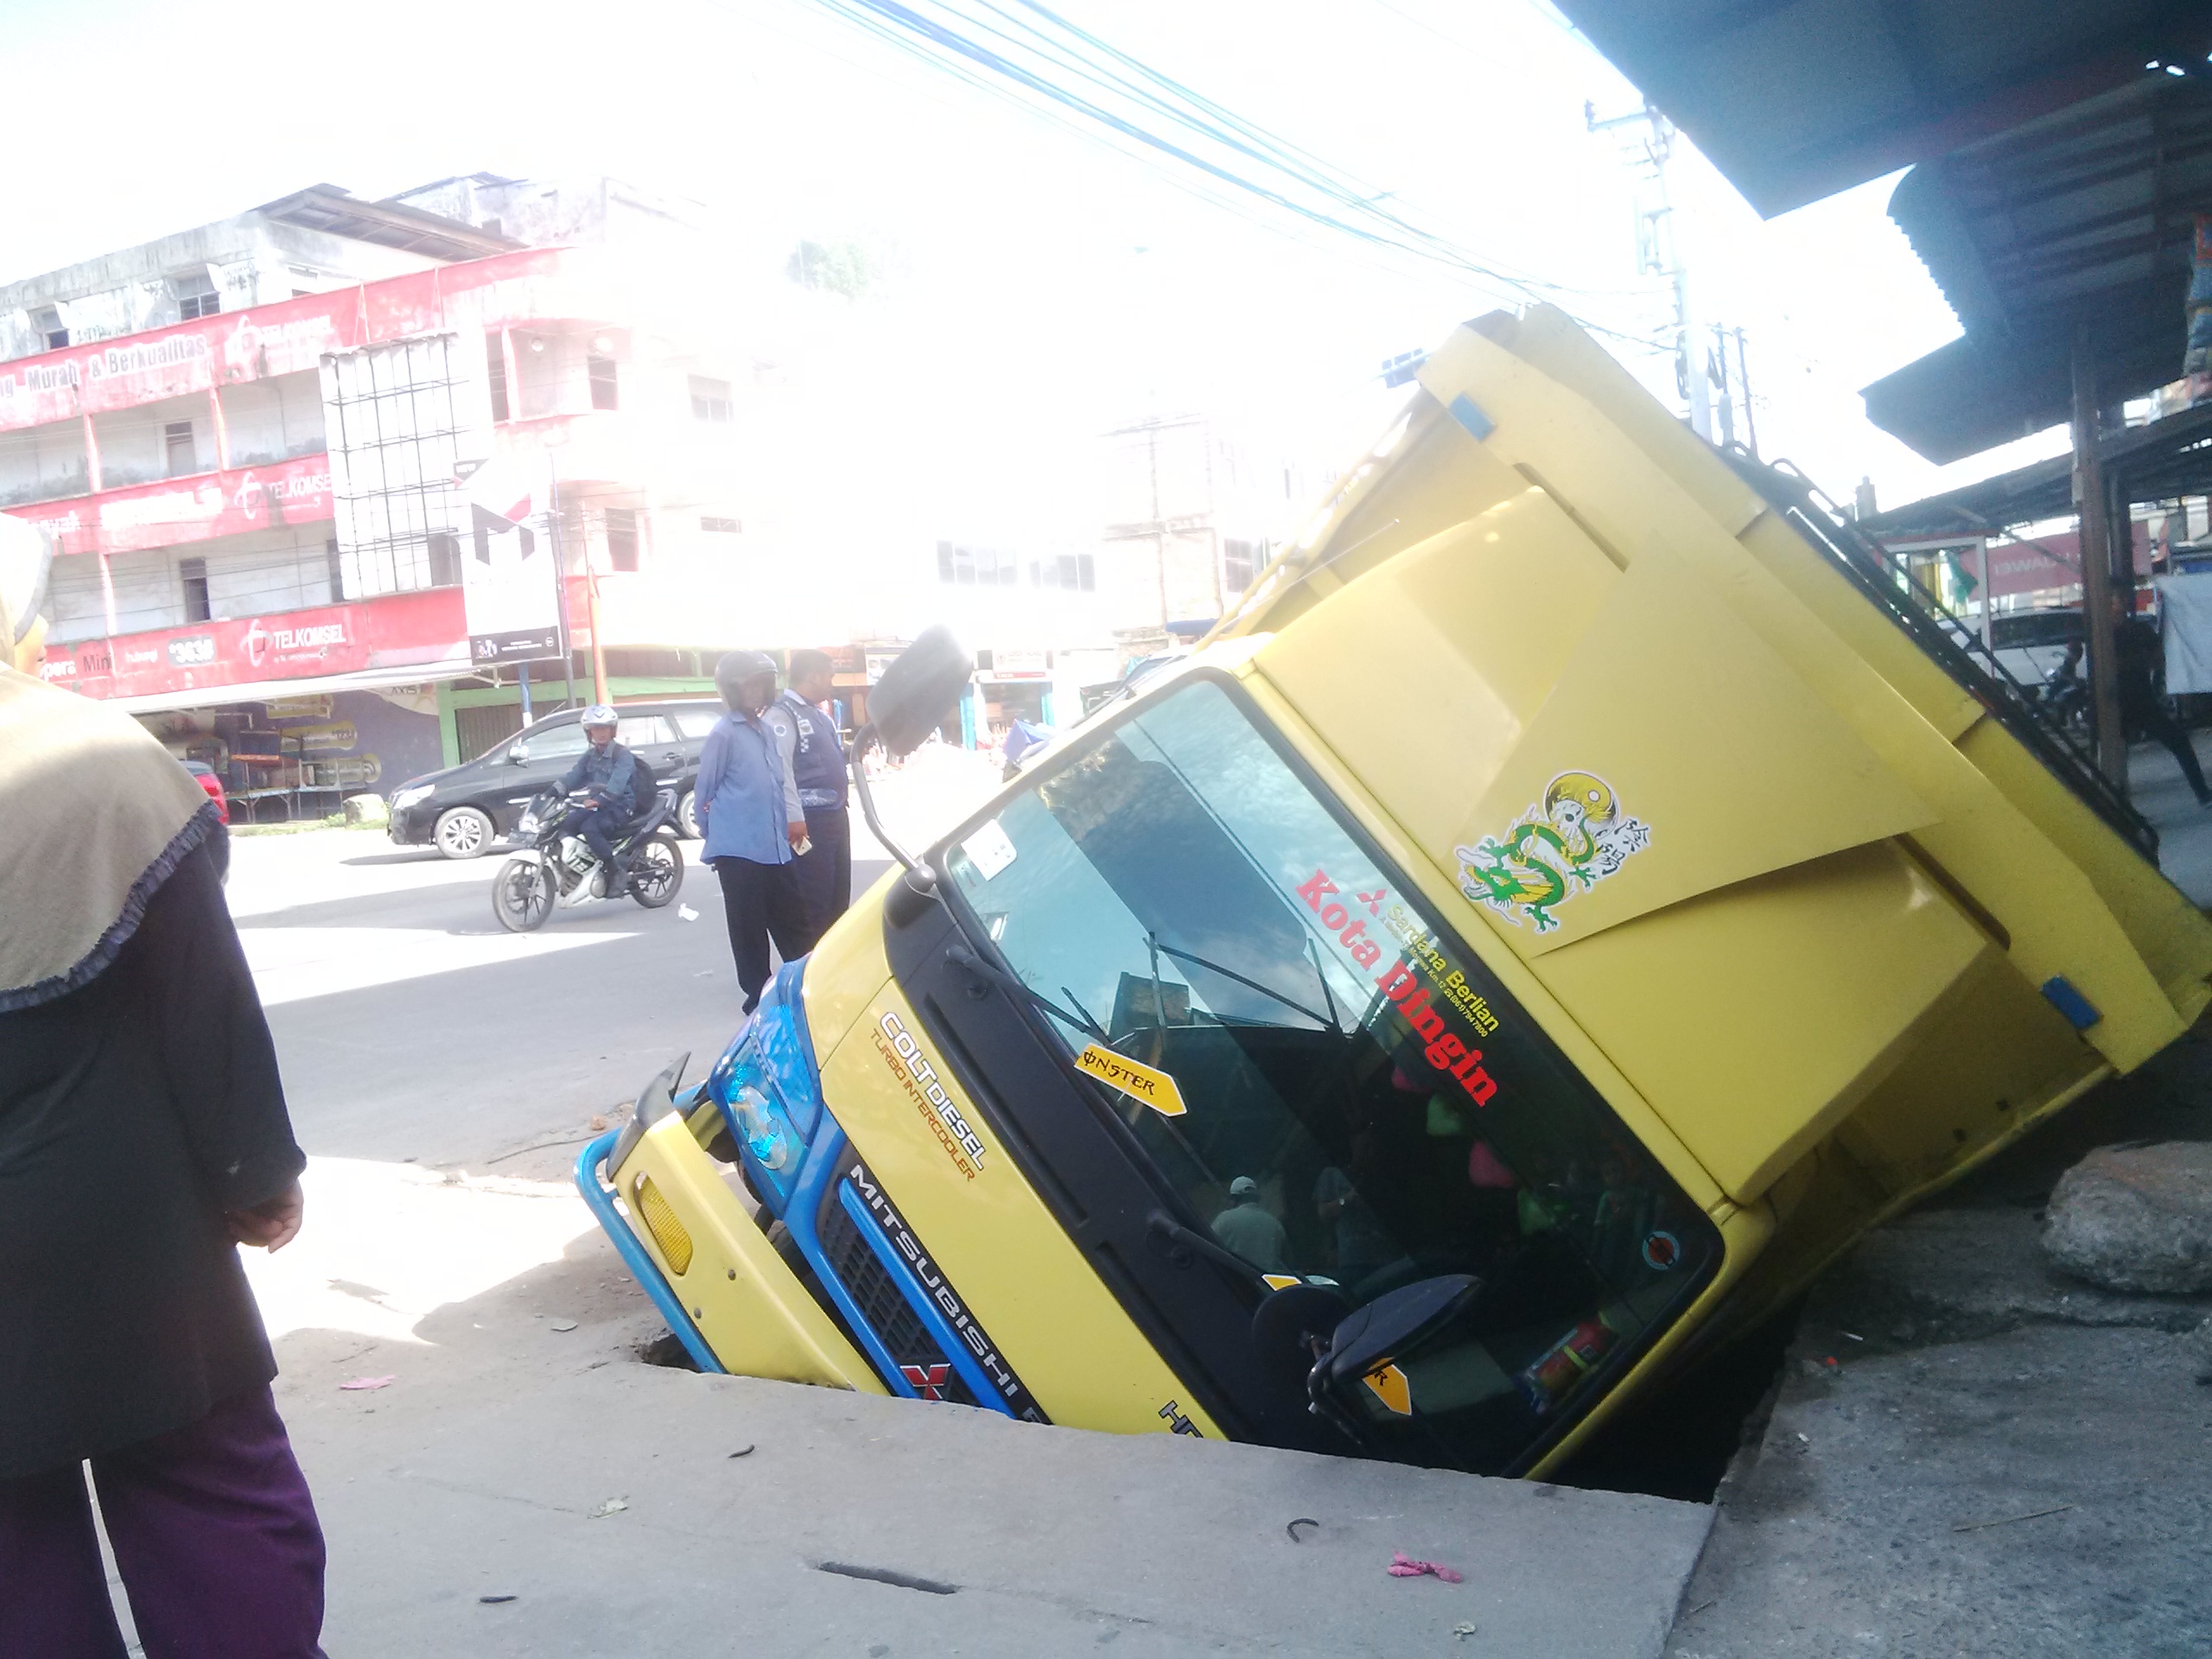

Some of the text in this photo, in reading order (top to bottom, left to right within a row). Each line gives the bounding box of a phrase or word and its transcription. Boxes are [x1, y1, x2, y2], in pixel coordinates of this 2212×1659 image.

[28, 359, 79, 391] Murah
[91, 359, 103, 378] &
[109, 334, 207, 374] Berkualitas
[270, 474, 333, 500] TELKOMSE
[40, 659, 77, 683] pera
[273, 624, 346, 649] TELKOMSEL
[1295, 868, 1498, 1107] Kota Dingin
[1386, 904, 1447, 973] Sardana
[1445, 969, 1500, 1033] Berlian
[870, 1027, 976, 1182] TURBO INTERCOOLER
[880, 1011, 985, 1172] COLT DIESEL
[850, 1164, 1018, 1397] MITSUBISHI
